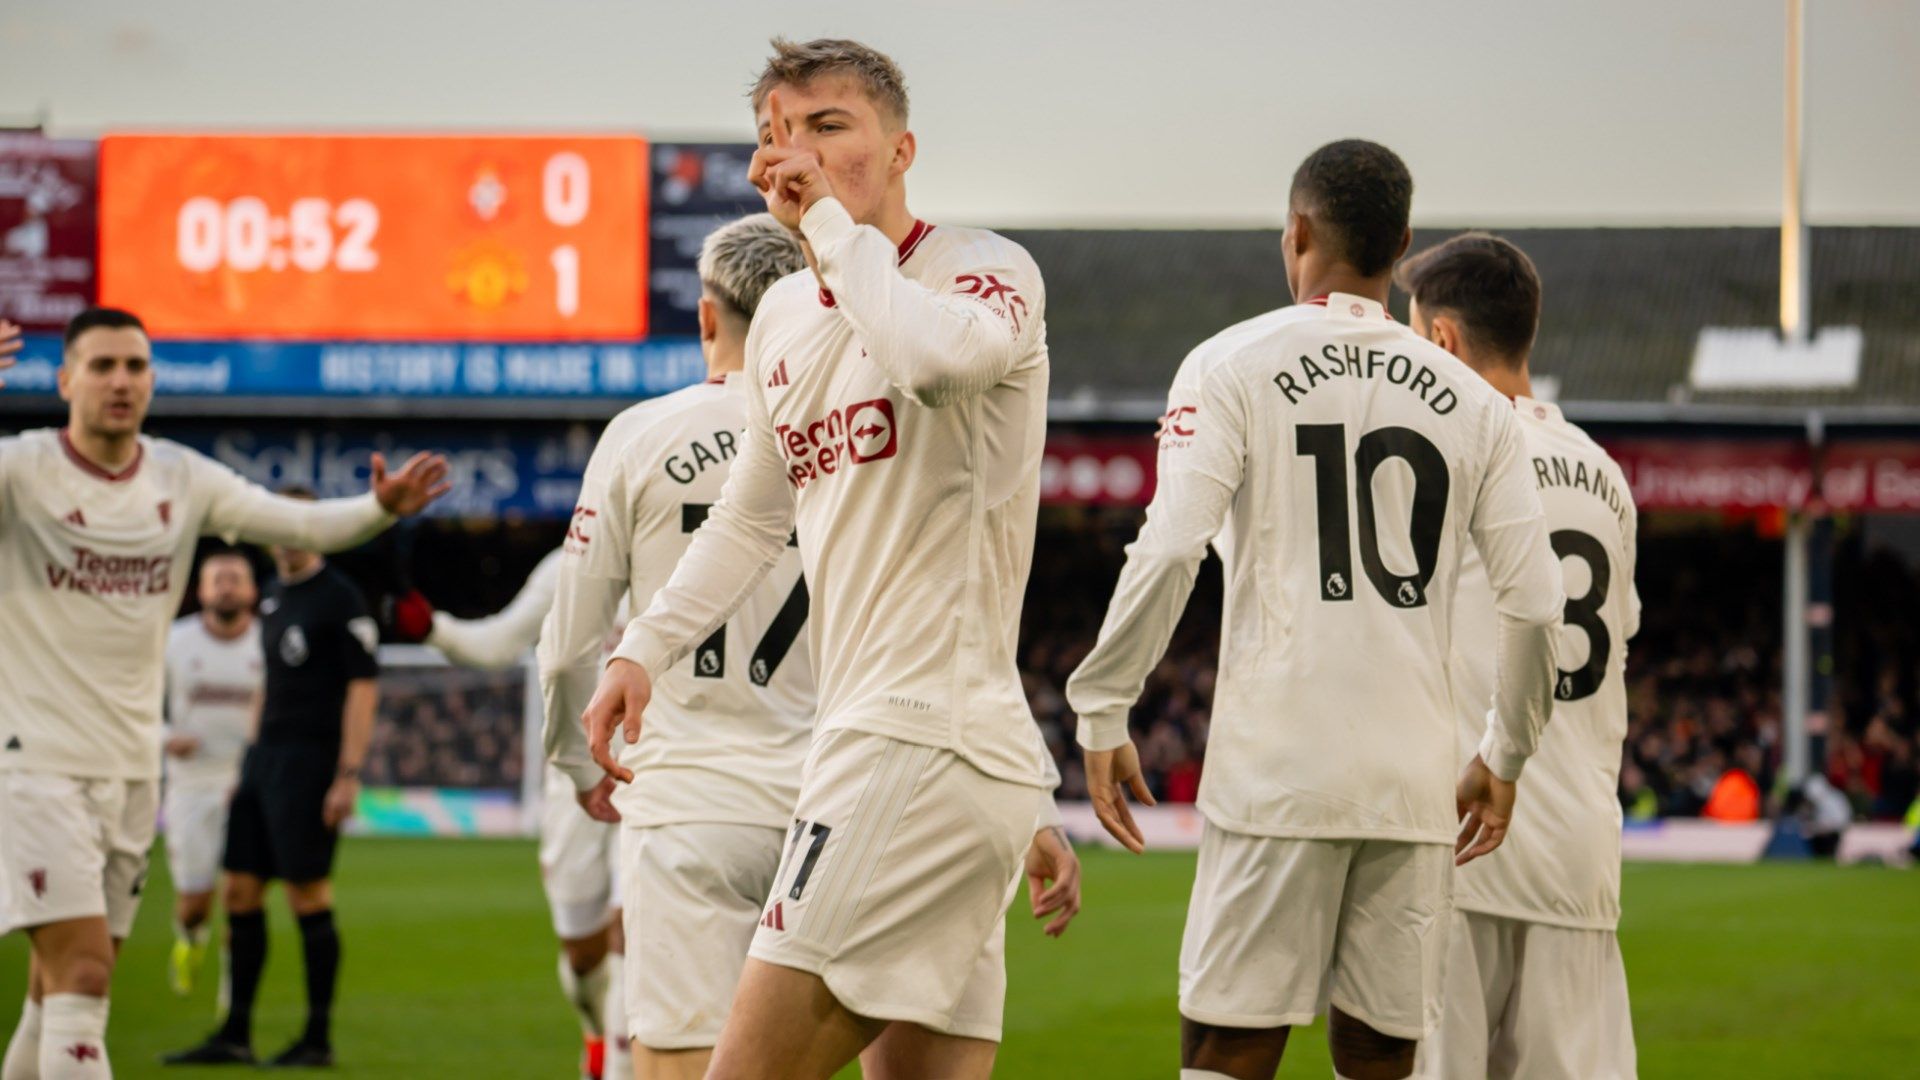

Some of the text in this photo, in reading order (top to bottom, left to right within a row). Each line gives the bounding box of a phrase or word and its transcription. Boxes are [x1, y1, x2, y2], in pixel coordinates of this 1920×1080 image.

[543, 151, 590, 227] 0
[177, 196, 380, 273] 00:52
[550, 244, 579, 318] 1
[1273, 344, 1457, 415] RASHFORD
[665, 429, 745, 484] GAR
[1296, 423, 1450, 608] 10
[1532, 456, 1628, 538] RNANDE
[47, 563, 143, 597] Viewer
[72, 547, 146, 575] Team
